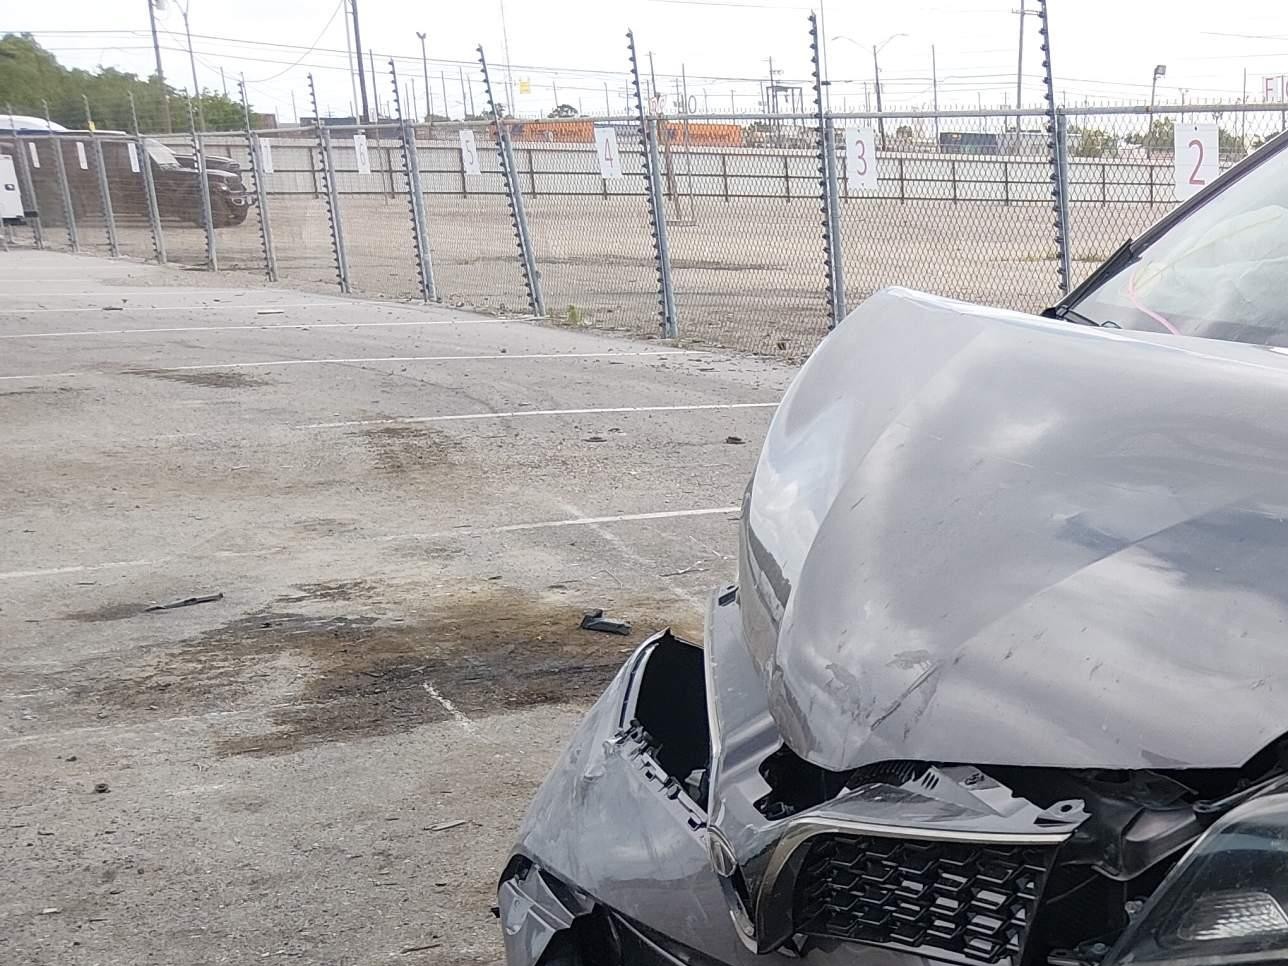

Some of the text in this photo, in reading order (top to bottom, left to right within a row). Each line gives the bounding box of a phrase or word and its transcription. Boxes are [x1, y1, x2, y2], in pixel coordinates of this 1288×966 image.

[604, 137, 614, 169] 4
[855, 139, 867, 176] 3
[1188, 139, 1206, 186] 2
